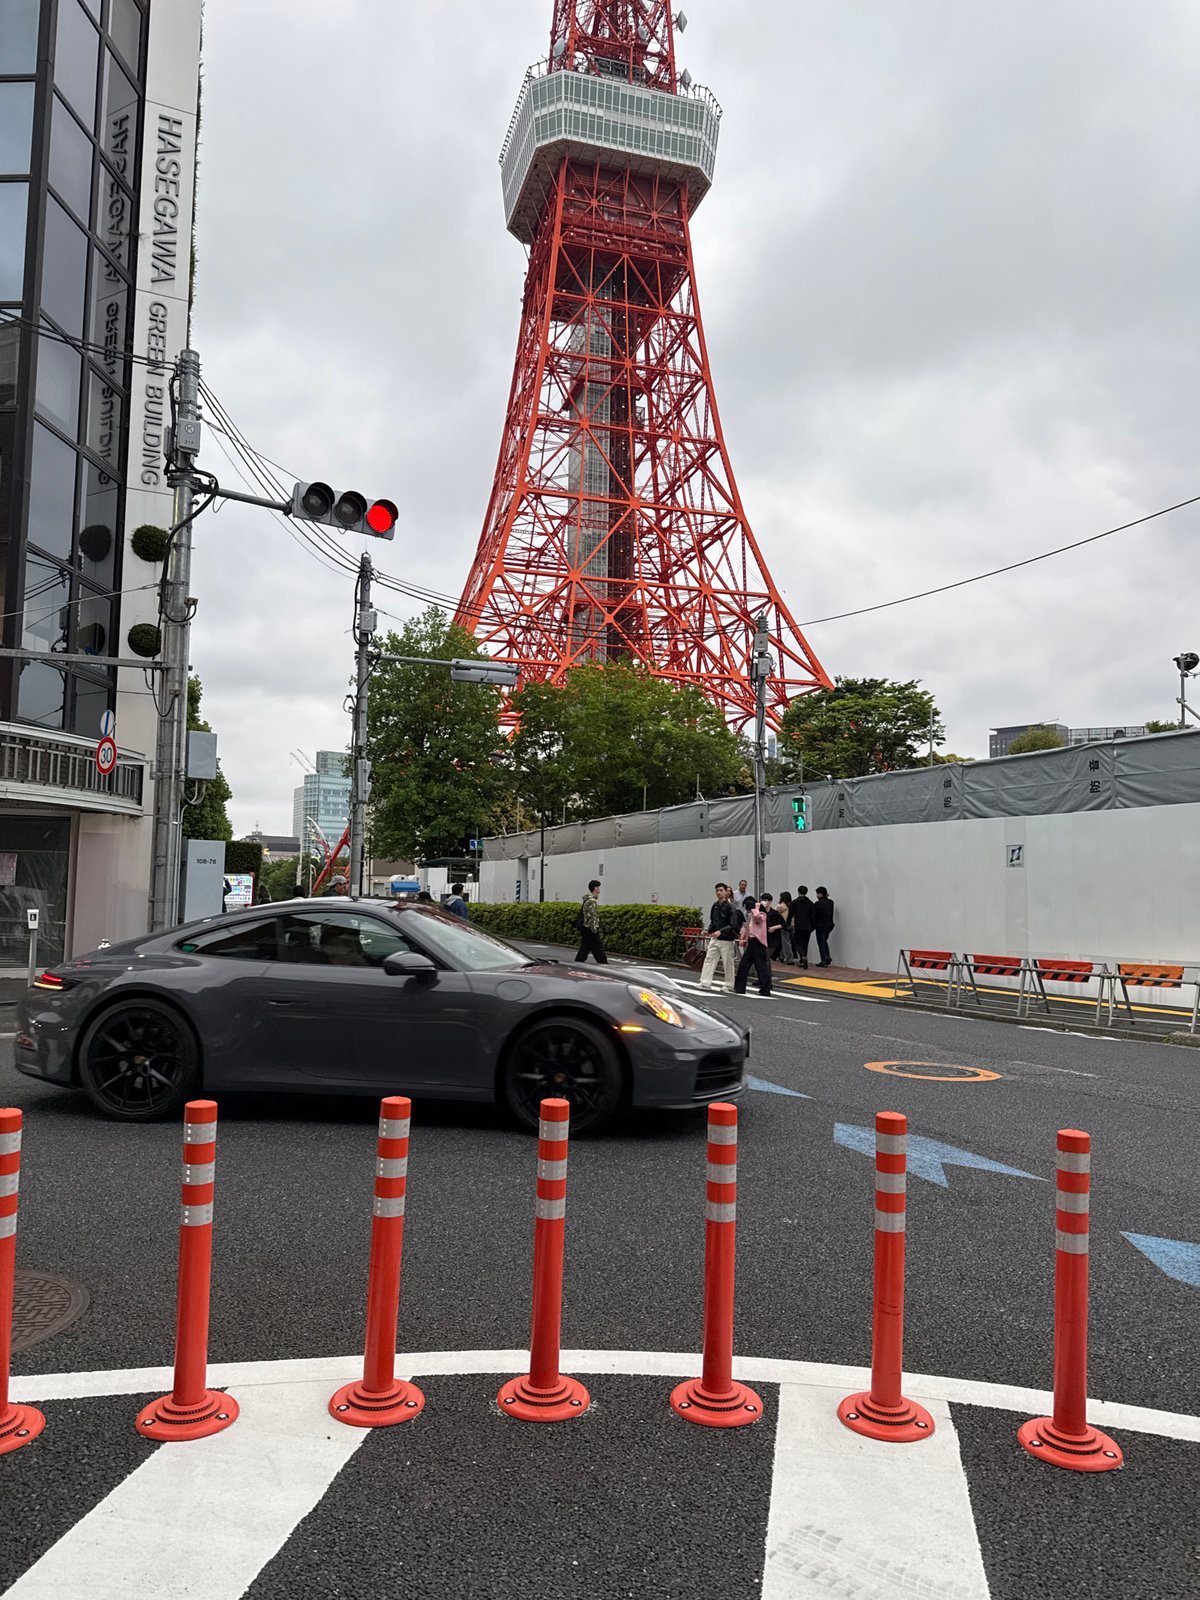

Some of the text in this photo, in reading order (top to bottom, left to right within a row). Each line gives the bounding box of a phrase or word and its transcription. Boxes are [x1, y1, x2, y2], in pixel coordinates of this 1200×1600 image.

[151, 113, 182, 283] HASEGAWA
[141, 301, 168, 486] GREEN BUILDING
[101, 747, 112, 764] 30
[1089, 760, 1101, 793] 防音
